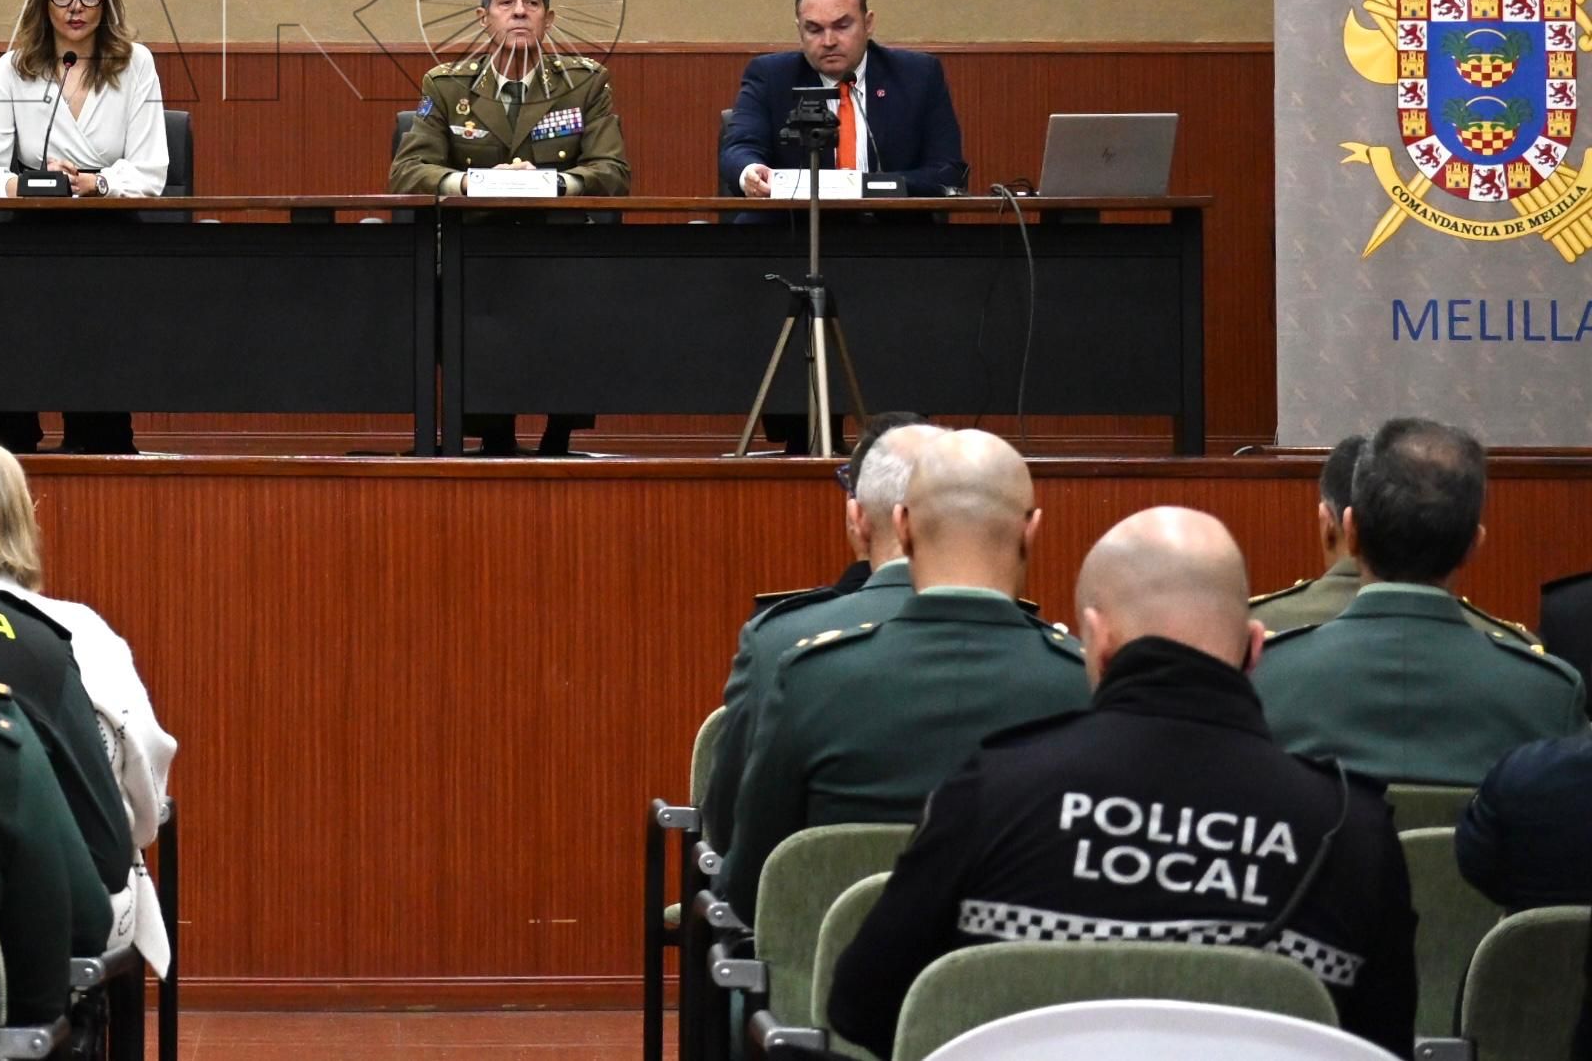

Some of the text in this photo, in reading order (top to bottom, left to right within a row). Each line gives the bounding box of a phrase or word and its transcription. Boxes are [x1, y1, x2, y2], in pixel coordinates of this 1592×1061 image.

[1391, 184, 1588, 237] COMANDANCIA DE MELILLA
[1059, 792, 1298, 864] POLICIA
[1073, 840, 1269, 906] LOCAL
